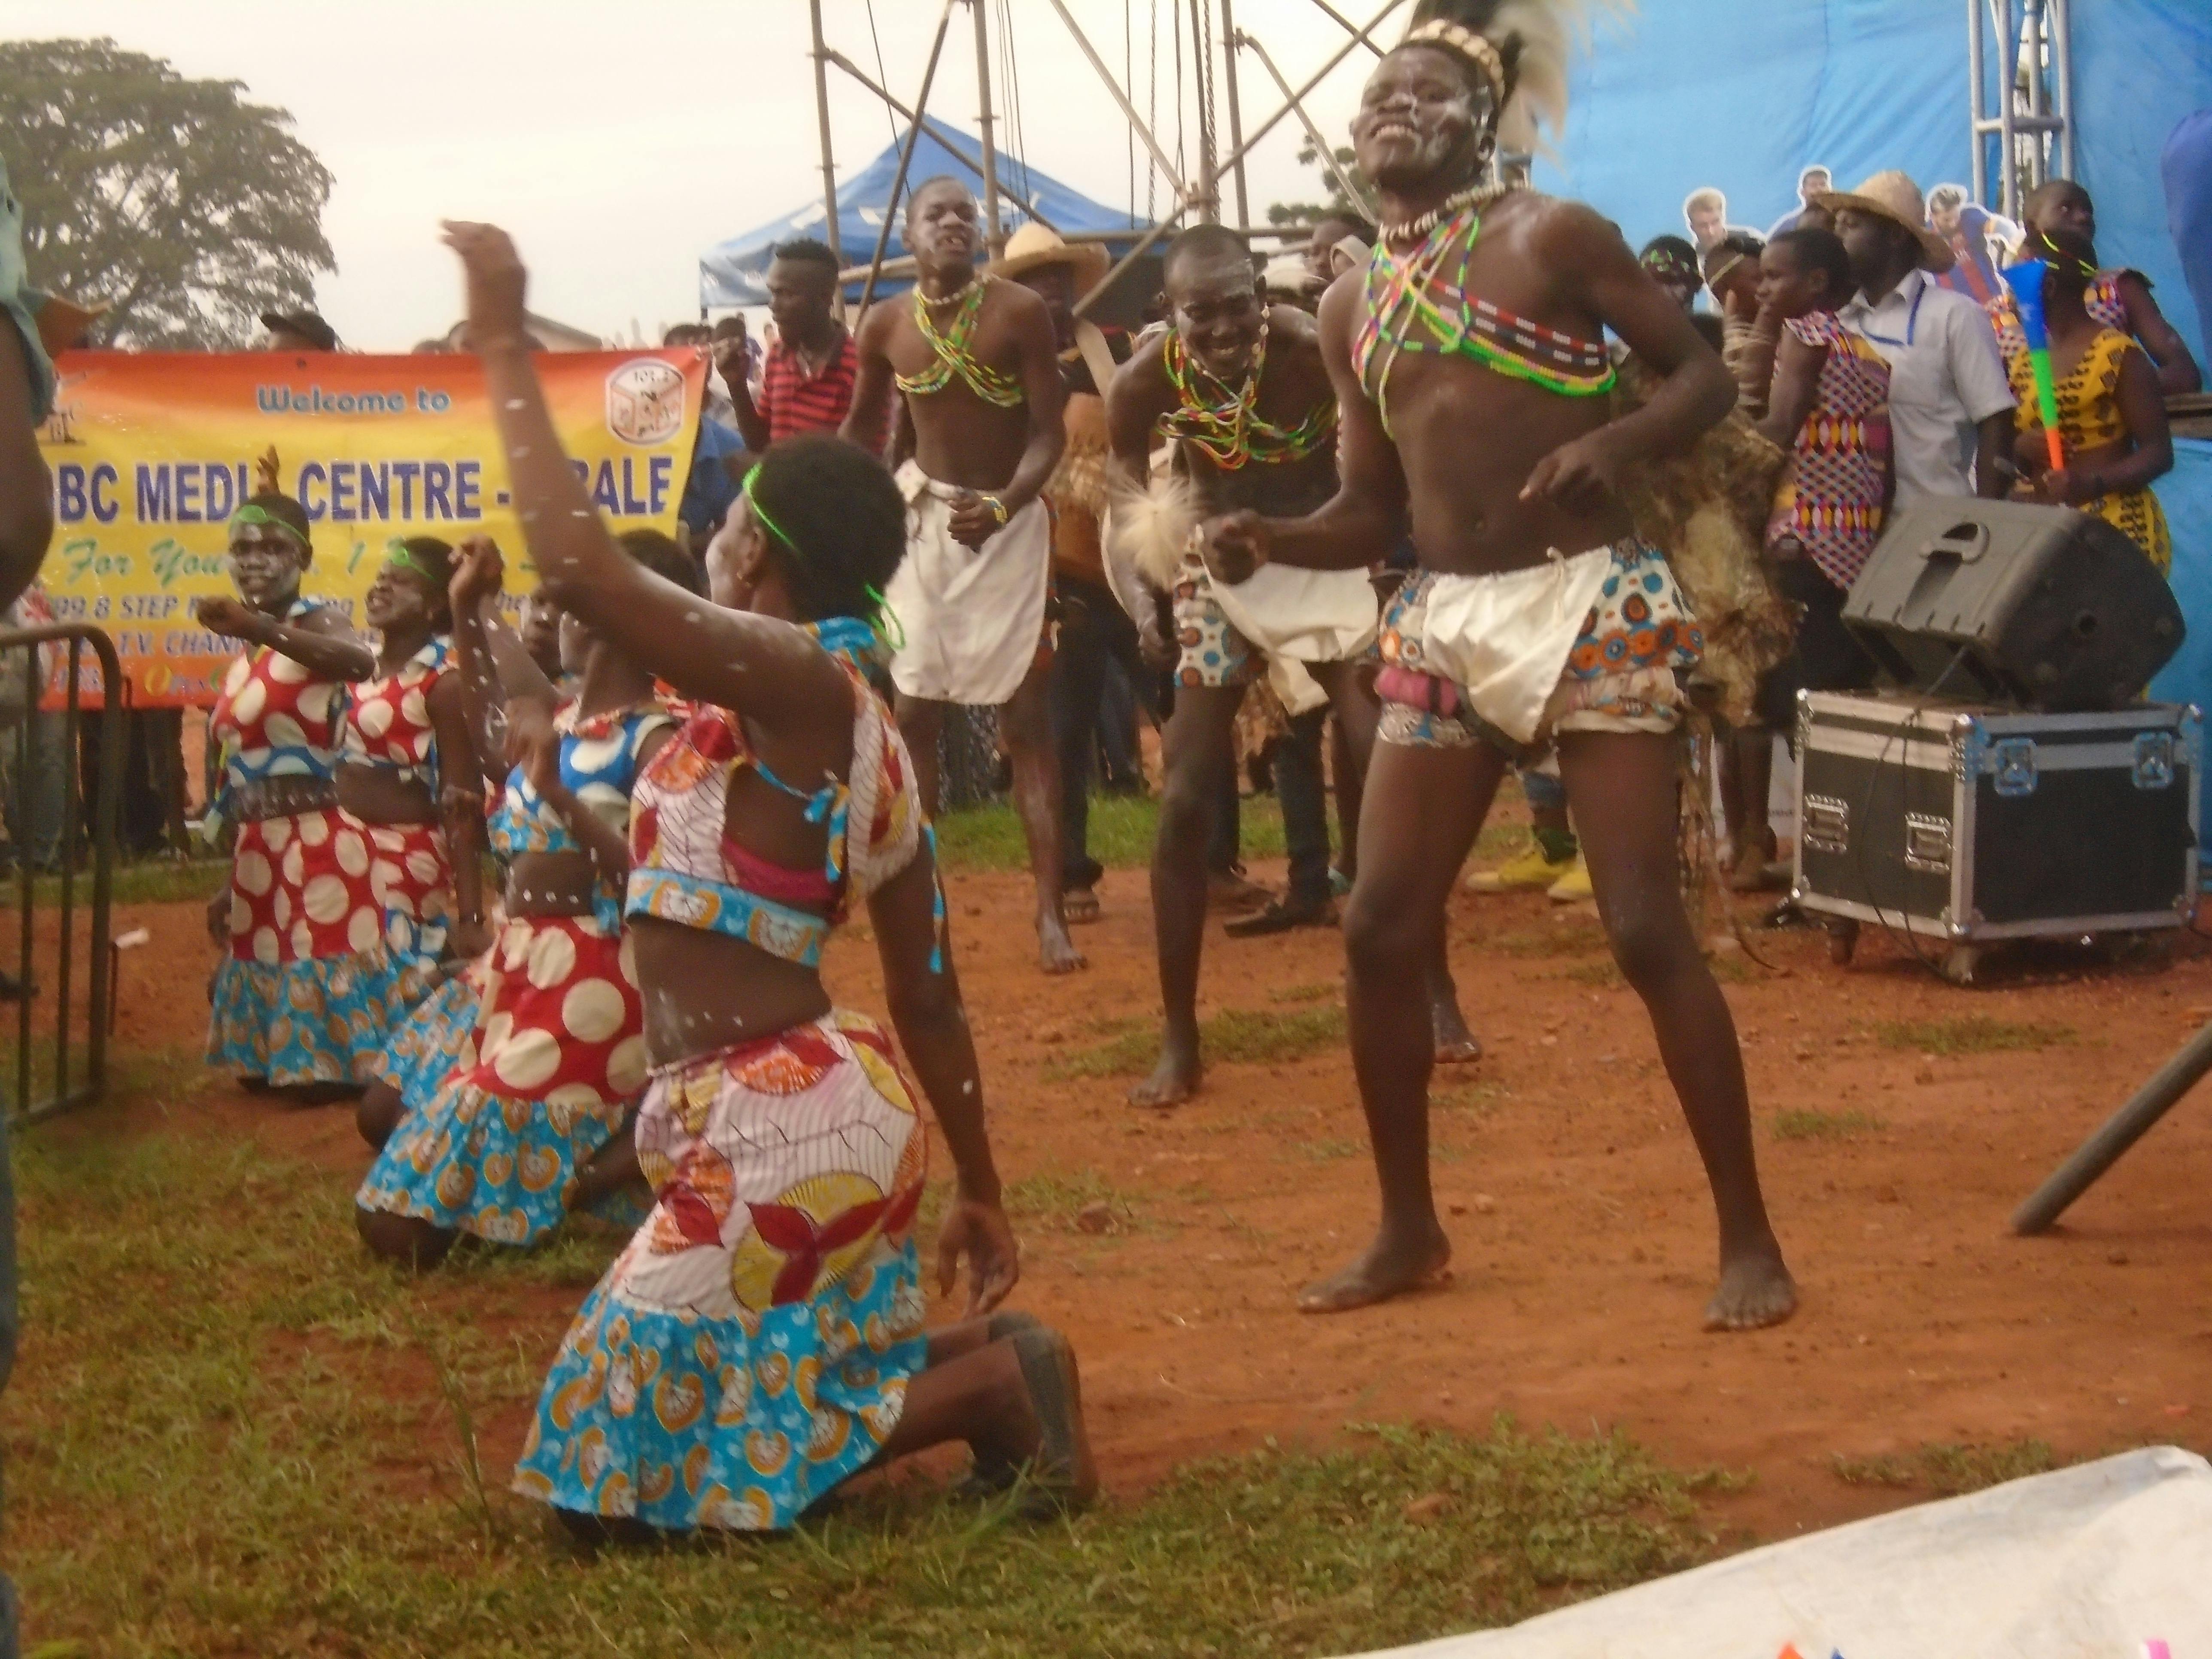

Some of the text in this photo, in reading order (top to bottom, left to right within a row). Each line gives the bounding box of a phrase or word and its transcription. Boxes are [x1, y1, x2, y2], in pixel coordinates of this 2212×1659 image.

[258, 386, 450, 413] Welcome to
[52, 462, 120, 523] BC
[136, 462, 251, 523] MEDI
[298, 460, 482, 522] CENTRE
[63, 539, 225, 587] For You
[119, 595, 178, 618] STEP
